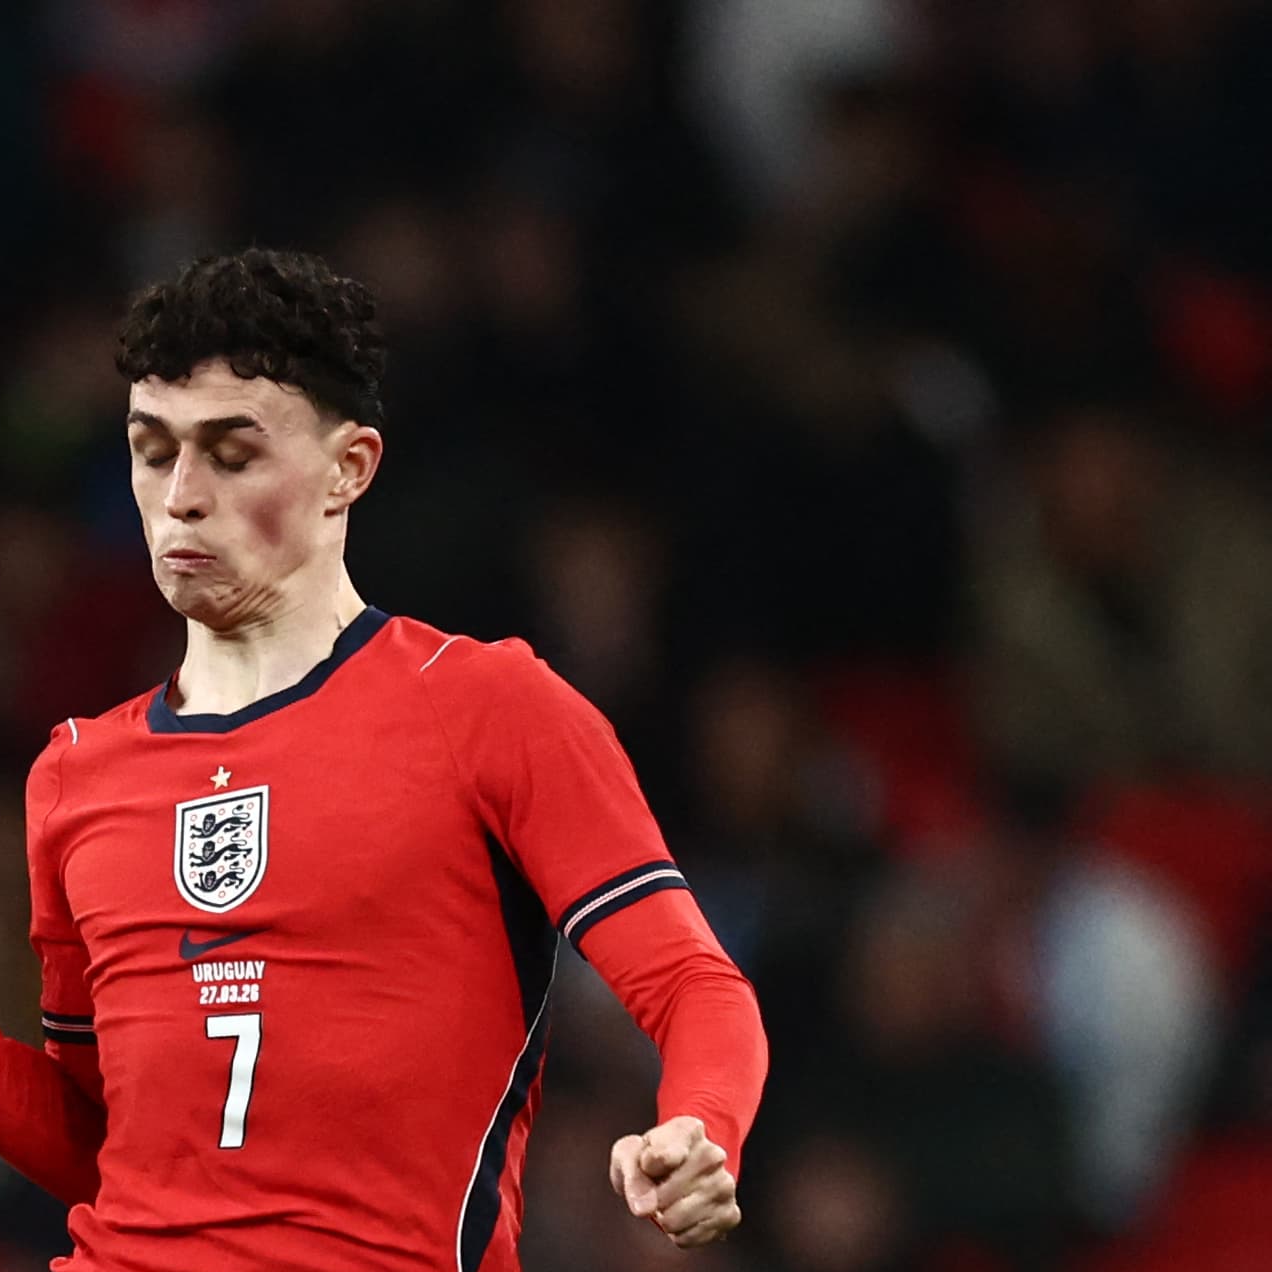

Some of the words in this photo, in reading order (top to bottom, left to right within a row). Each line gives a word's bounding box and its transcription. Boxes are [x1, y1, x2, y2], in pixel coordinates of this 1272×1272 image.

[192, 960, 265, 983] URUGUAY
[199, 983, 260, 1005] 27.03.26
[205, 1013, 262, 1149] 7
